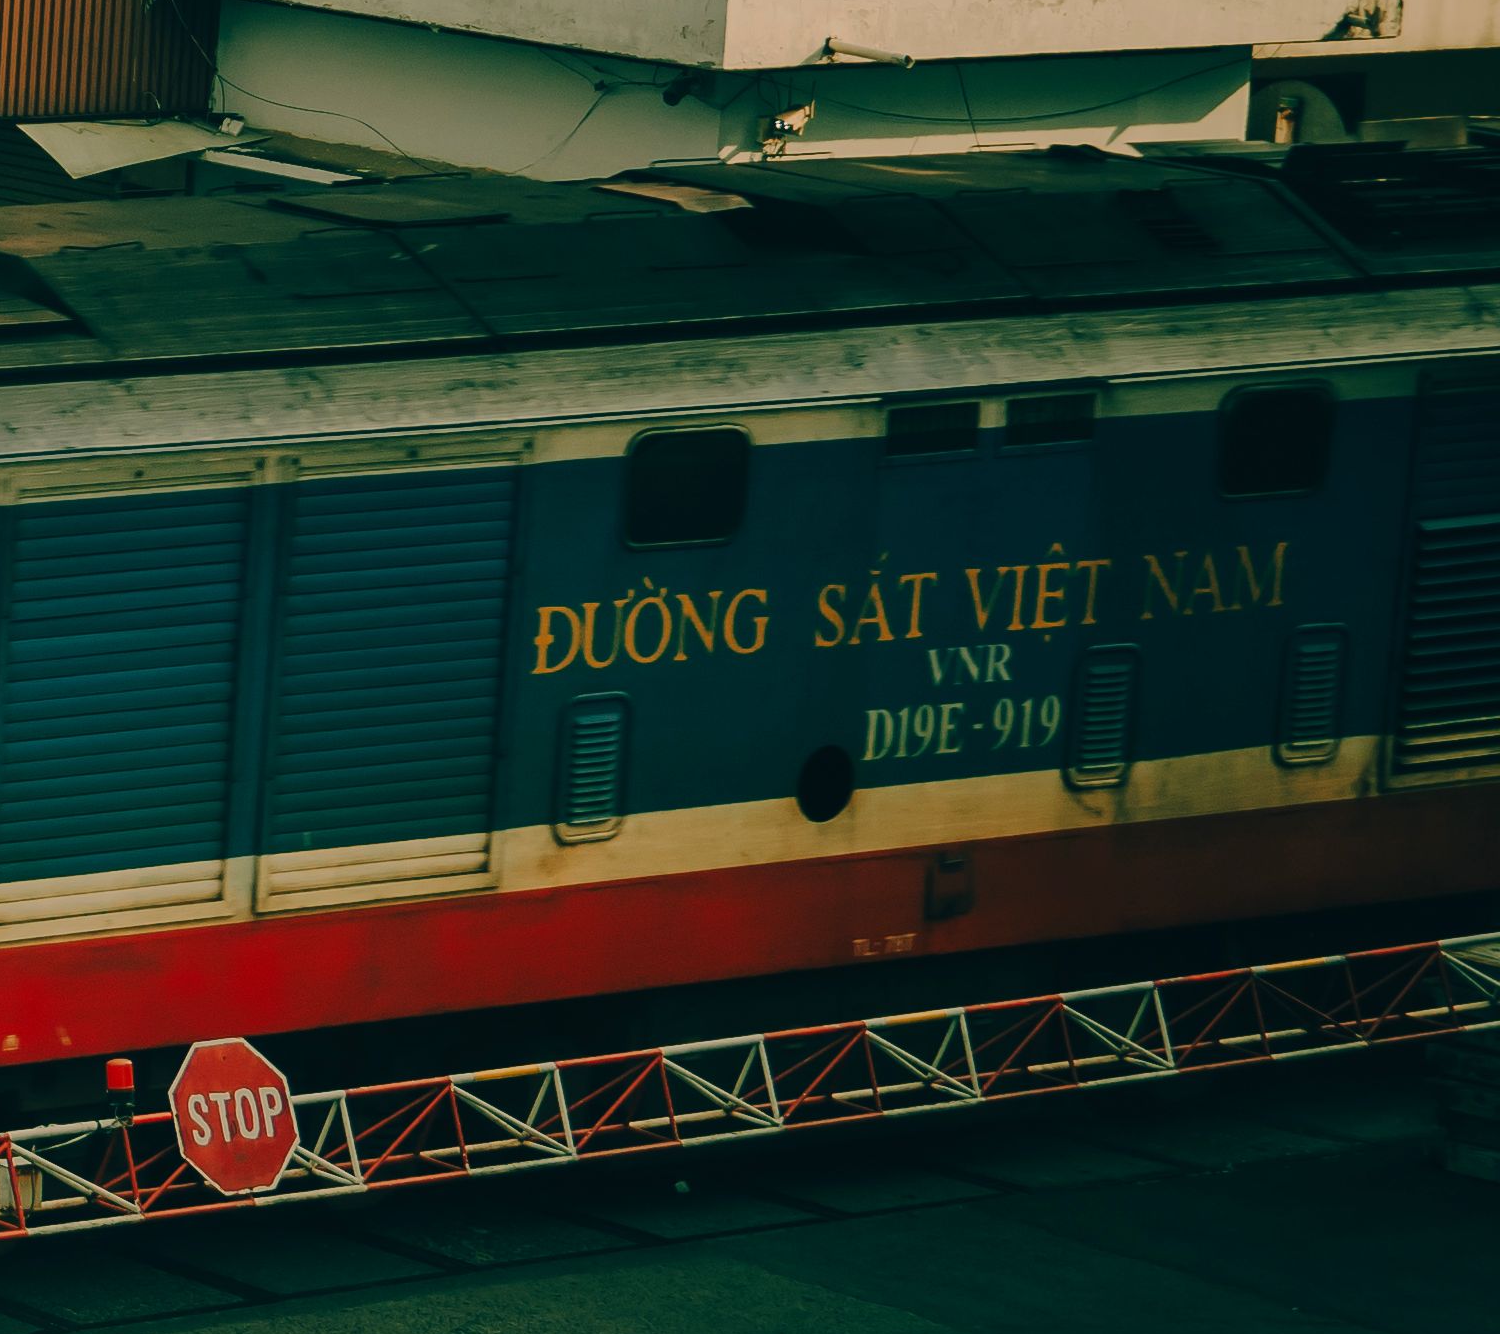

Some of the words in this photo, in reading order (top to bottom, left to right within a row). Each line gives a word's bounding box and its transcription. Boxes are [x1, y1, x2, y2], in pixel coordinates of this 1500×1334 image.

[529, 575, 770, 675] ĐƯỜNG
[813, 552, 939, 648] SẮT
[964, 542, 1113, 643] VIỆT
[1139, 540, 1291, 620] NAM
[927, 643, 1012, 685] VNR
[188, 1086, 284, 1147] STOP
